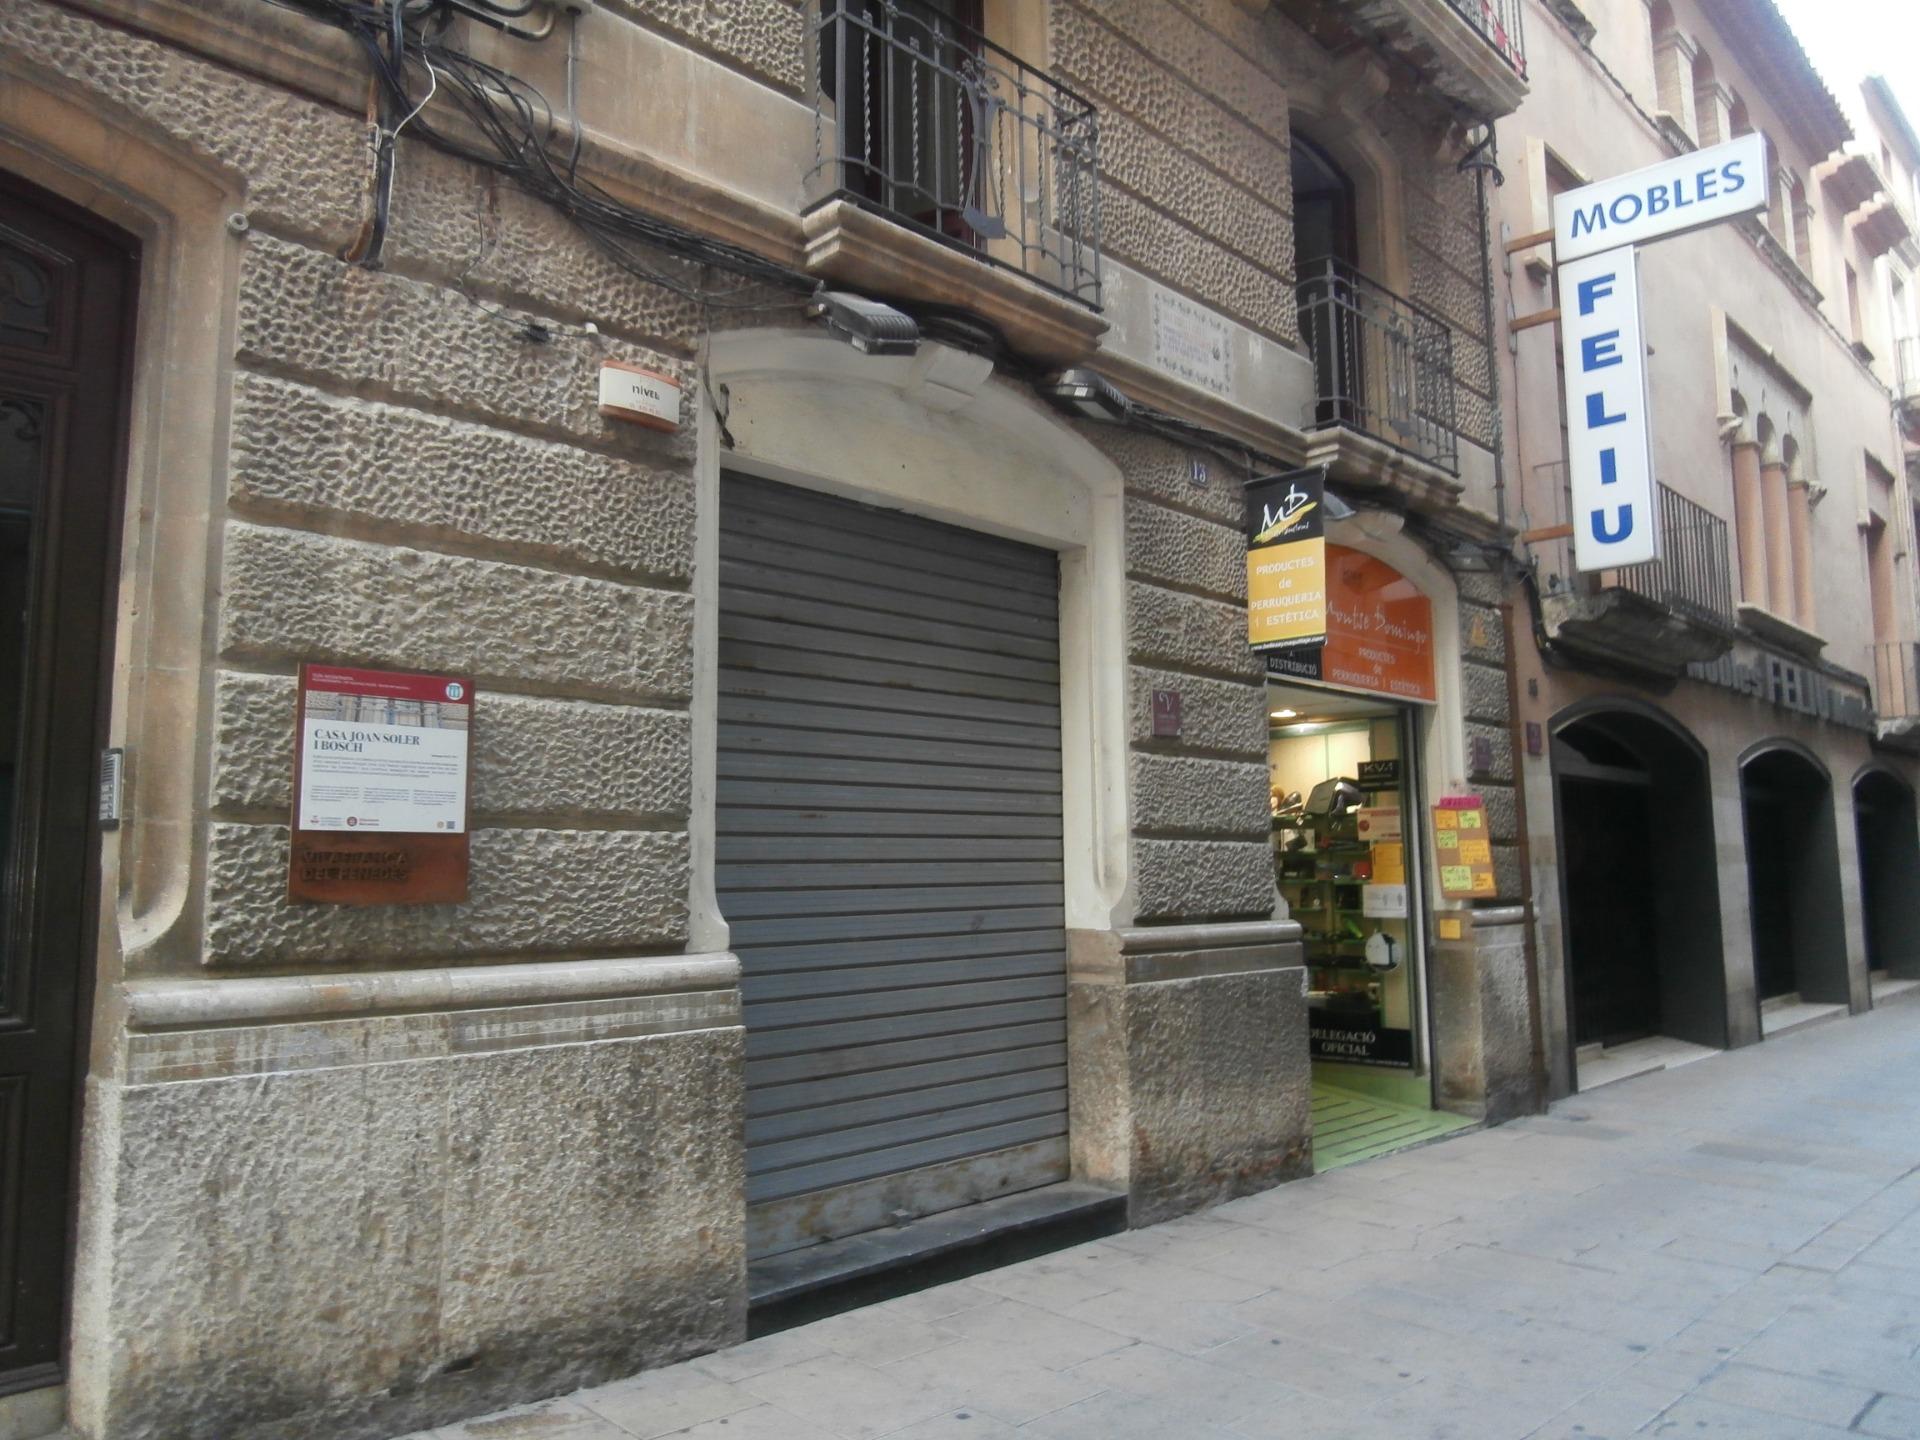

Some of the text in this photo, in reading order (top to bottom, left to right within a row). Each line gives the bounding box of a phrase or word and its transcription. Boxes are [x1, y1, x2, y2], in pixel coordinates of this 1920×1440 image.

[1570, 160, 1745, 239] MOBLES
[1577, 272, 1634, 544] FELIU
[1256, 555, 1315, 576] PRODUCTES
[1278, 577, 1292, 589] de
[1250, 590, 1323, 611] PERRUQUERIA
[1375, 602, 1427, 654] Domingo
[1269, 657, 1318, 675] DISTRIBUCIÓ
[313, 740, 363, 753] I BOSCH
[314, 728, 421, 746] CASA JOAN SOLER
[1321, 1041, 1372, 1057] OFICIAL
